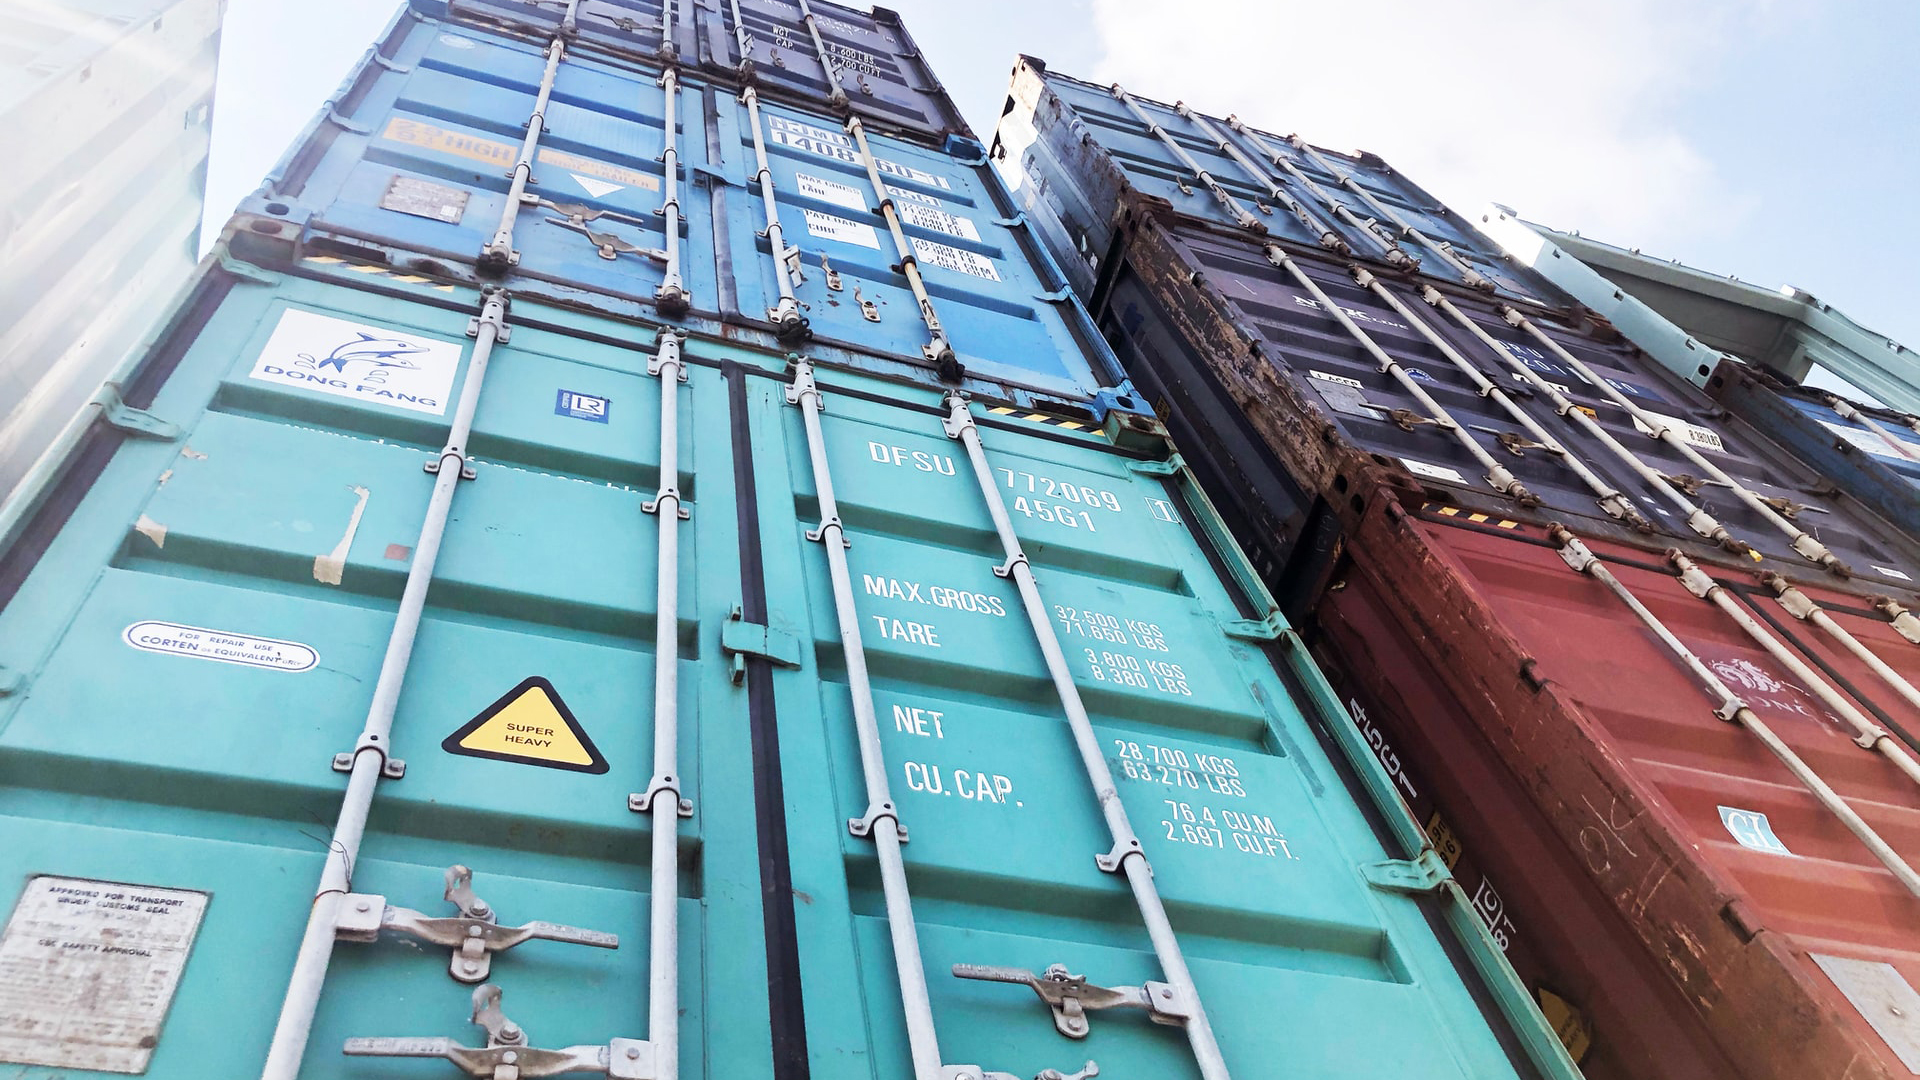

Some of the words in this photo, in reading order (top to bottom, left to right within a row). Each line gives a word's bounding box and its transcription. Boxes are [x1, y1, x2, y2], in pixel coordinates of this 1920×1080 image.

[776, 131, 855, 163] 1408
[263, 365, 347, 390] DONG
[356, 384, 437, 408] FANG
[577, 397, 601, 413] LR
[868, 441, 956, 477] DFSU
[997, 467, 1122, 513] 772069
[1014, 496, 1096, 533] 45G1
[872, 615, 942, 647] TARE
[1054, 604, 1119, 631] 32.500
[1124, 618, 1164, 639] KGS
[1060, 619, 1127, 645] 71.650
[1132, 632, 1170, 652] LBS
[140, 635, 199, 651] CORTEN
[214, 648, 281, 663] EQUIVALENT
[179, 632, 201, 640] FOR
[209, 636, 246, 648] REPAIR
[254, 644, 274, 652] USE
[1084, 648, 1143, 673] 3.800
[1148, 660, 1186, 680] KGS
[1091, 664, 1149, 689] 8.380
[1154, 676, 1193, 697] LBS
[506, 722, 555, 737] SUPER
[892, 704, 944, 739] NET
[504, 734, 552, 748] HEAVY
[1114, 739, 1191, 769] 28.700
[1194, 754, 1240, 778] KGS
[1122, 759, 1199, 790] 63.270
[1203, 775, 1248, 799] LBS
[1164, 799, 1217, 827] 76.4
[1161, 820, 1225, 849] 2.697
[49, 886, 100, 898] APPROVED
[105, 892, 125, 900] FOR
[130, 895, 185, 907] TRANSPORT
[58, 897, 90, 905] UNDER
[97, 900, 141, 911] CUSTOMS
[146, 906, 170, 915] SEAL
[62, 941, 100, 952] SAFETY
[102, 945, 153, 958] APPROVAL
